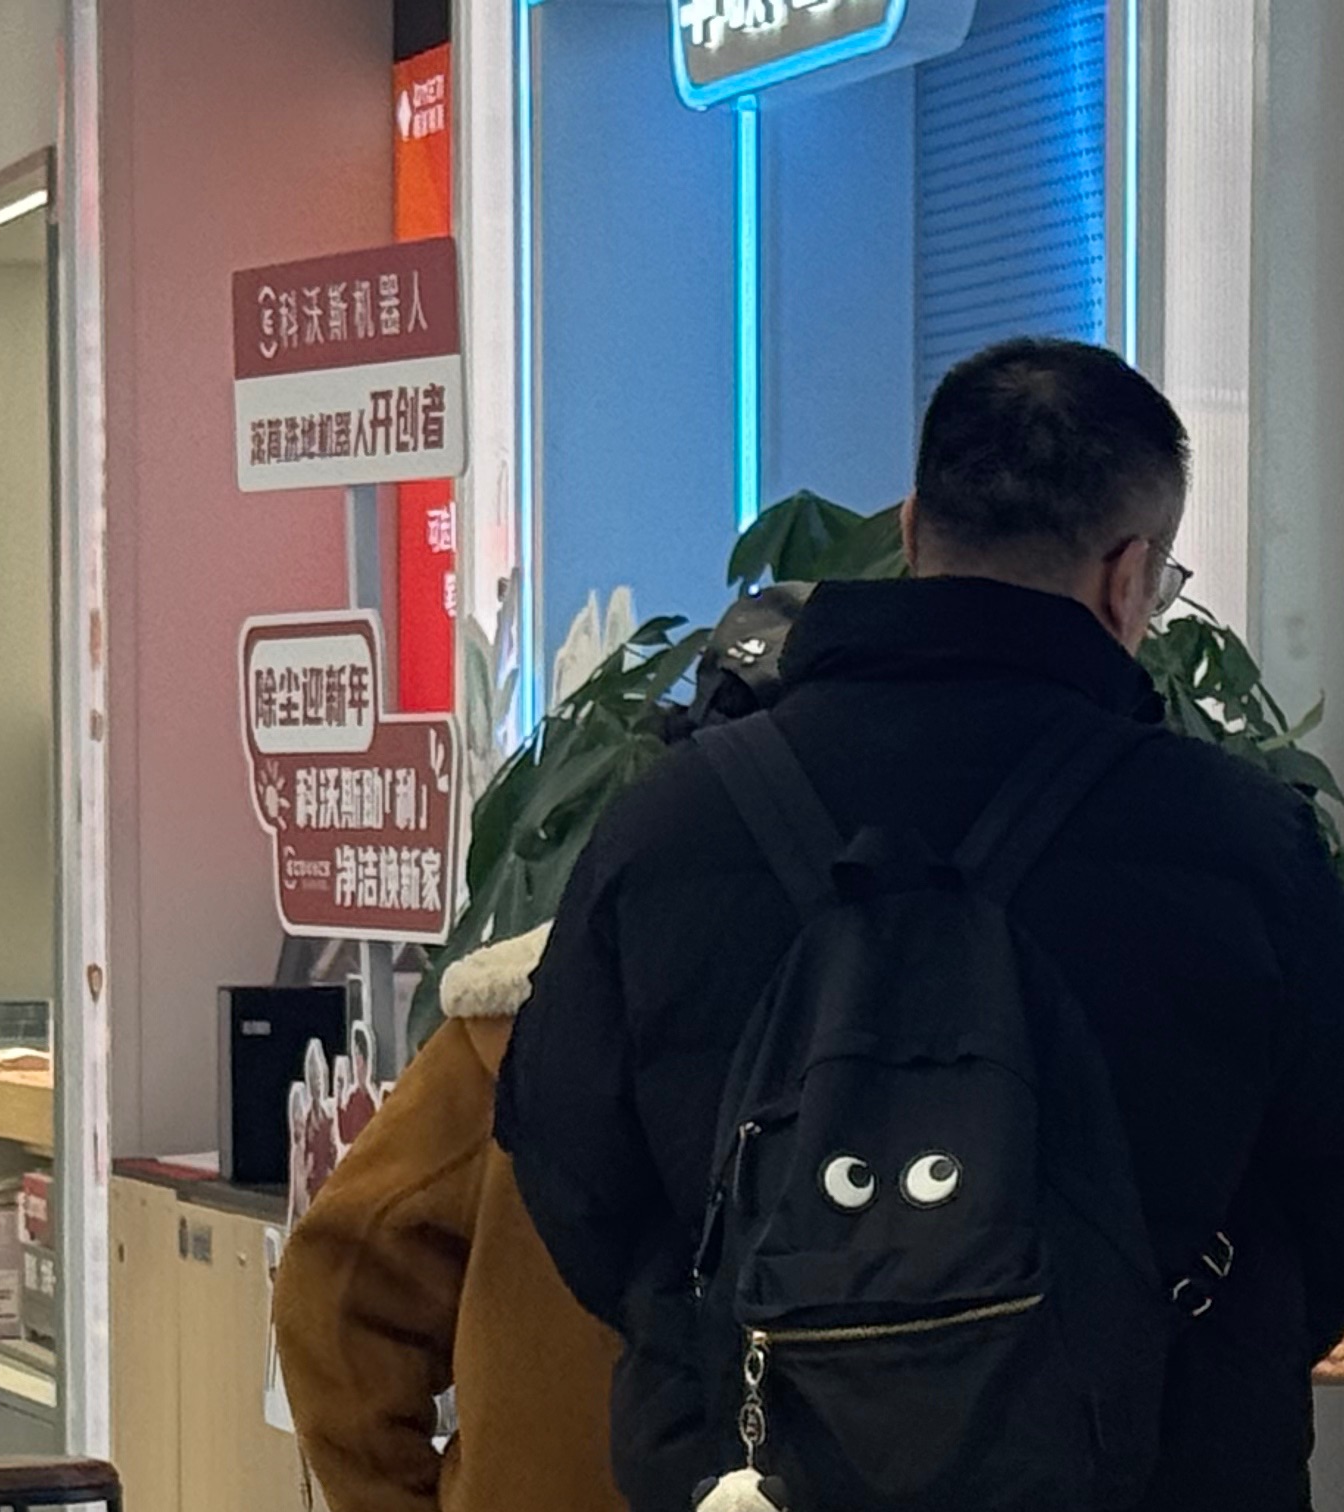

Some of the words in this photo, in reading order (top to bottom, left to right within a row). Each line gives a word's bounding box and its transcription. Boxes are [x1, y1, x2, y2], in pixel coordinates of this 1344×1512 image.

[278, 269, 429, 348] 科沃斯机器人
[250, 383, 446, 466] 滚筒洗地机器人开创者
[254, 662, 370, 730] 除尘迎新年
[335, 844, 442, 912] 净洁焕新家
